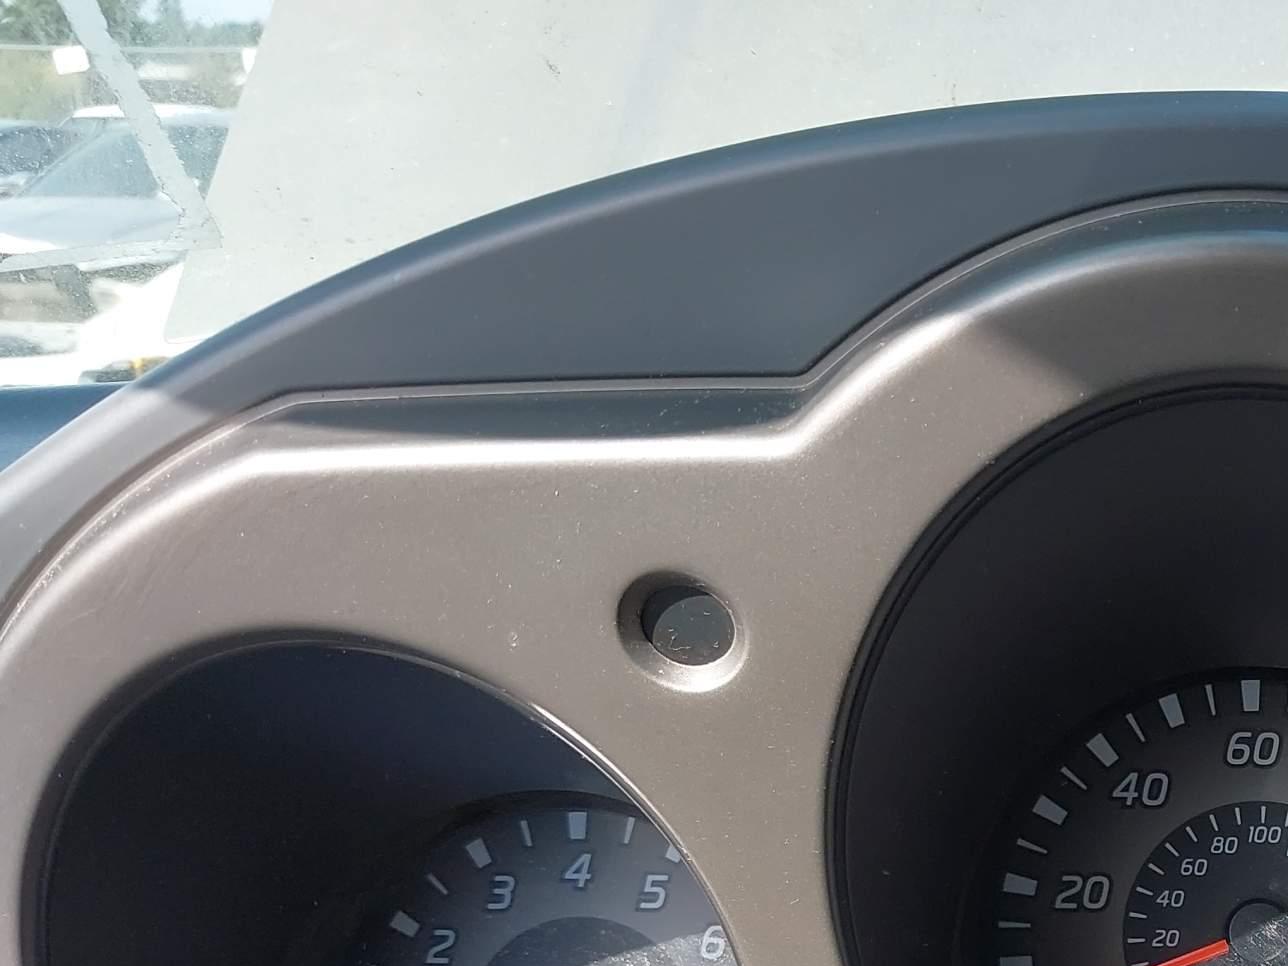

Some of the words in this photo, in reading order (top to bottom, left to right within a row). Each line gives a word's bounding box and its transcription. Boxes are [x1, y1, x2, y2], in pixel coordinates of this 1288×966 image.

[1227, 732, 1281, 767] 60
[1112, 773, 1169, 806] 40
[1210, 836, 1238, 855] 80
[1248, 825, 1282, 845] 100
[563, 853, 592, 888] 4
[1180, 858, 1208, 877] 60
[487, 875, 515, 911] 3
[639, 874, 668, 911] 5
[1054, 875, 1110, 909] 20
[1156, 889, 1185, 908] 40
[425, 929, 456, 964] 2
[701, 925, 726, 960] 6
[1151, 928, 1180, 948] 20
